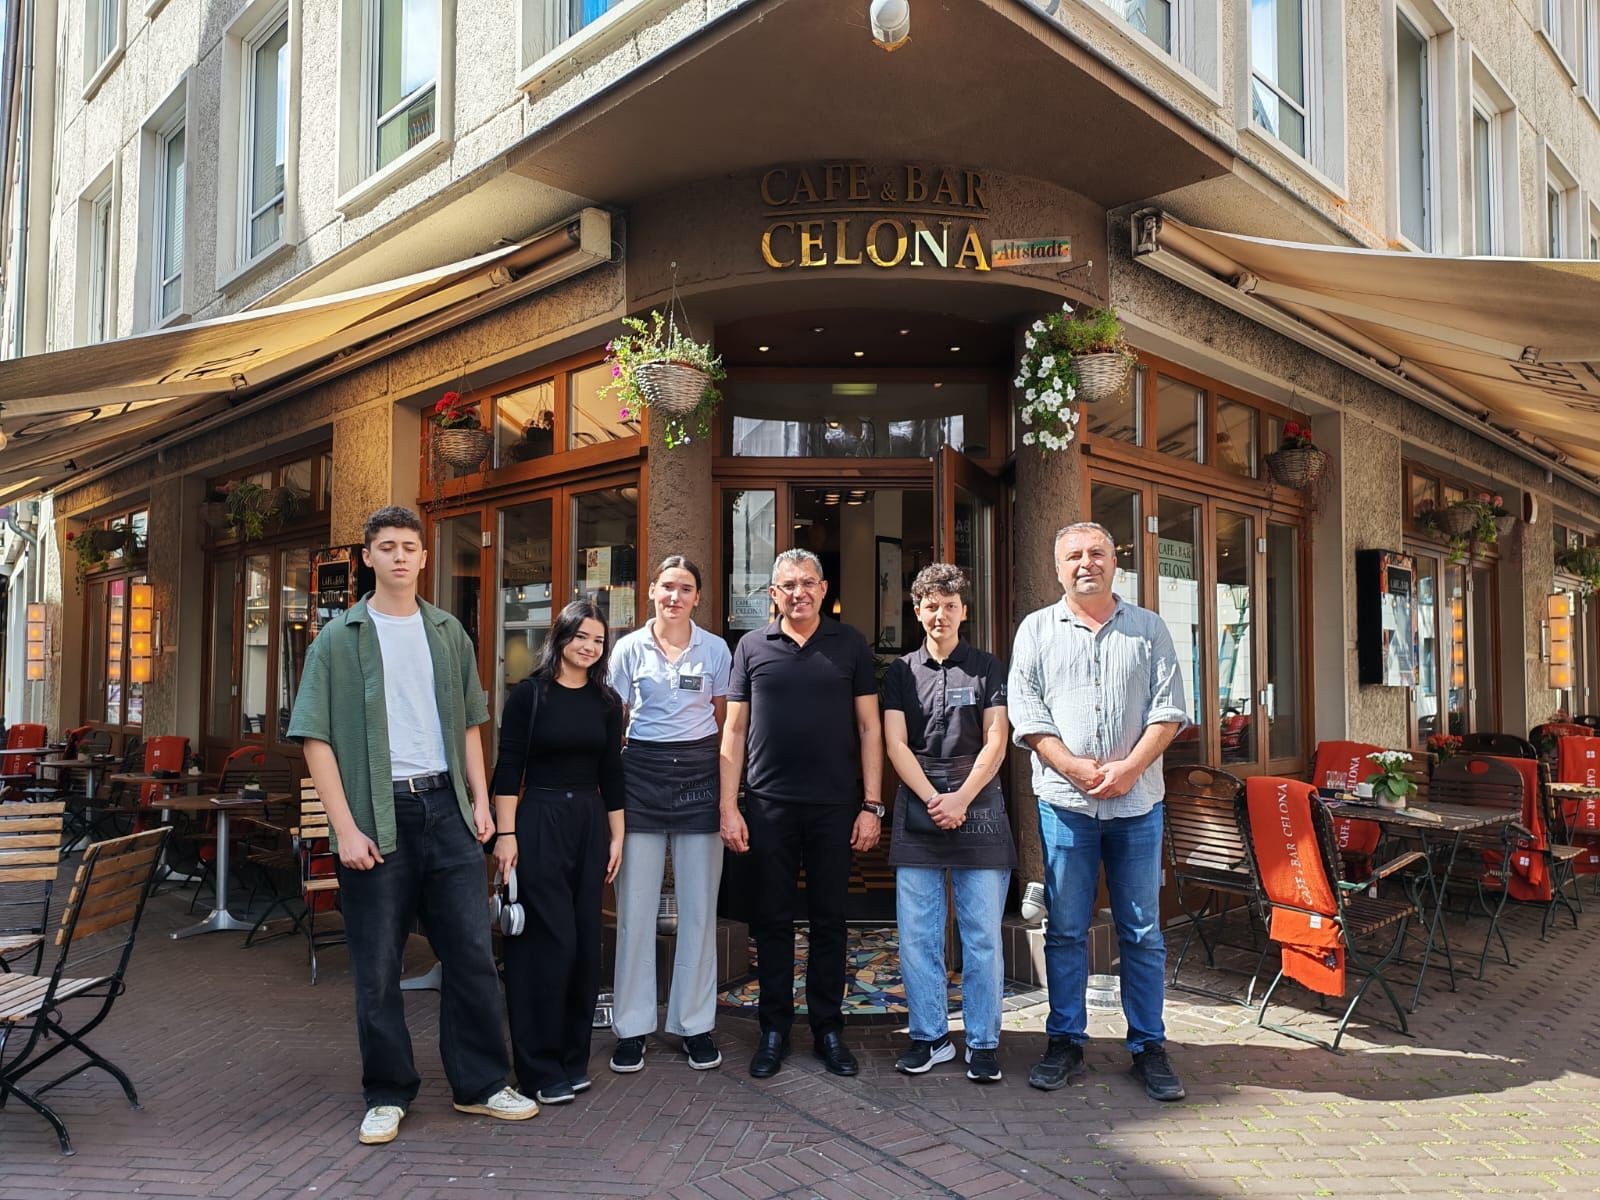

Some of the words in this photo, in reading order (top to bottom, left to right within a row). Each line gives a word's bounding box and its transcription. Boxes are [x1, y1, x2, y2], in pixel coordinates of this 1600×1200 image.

[760, 164, 870, 206] CAFE
[880, 181, 896, 201] &
[904, 165, 989, 209] BAR
[761, 218, 991, 271] CELONA
[998, 240, 1064, 262] Altstadt
[1159, 542, 1174, 556] CAFE
[1158, 562, 1193, 580] CELONA
[1277, 783, 1293, 837] CELONA
[1339, 824, 1350, 848] CAFE
[1346, 756, 1361, 791] ELONA
[1287, 843, 1302, 868] BAR
